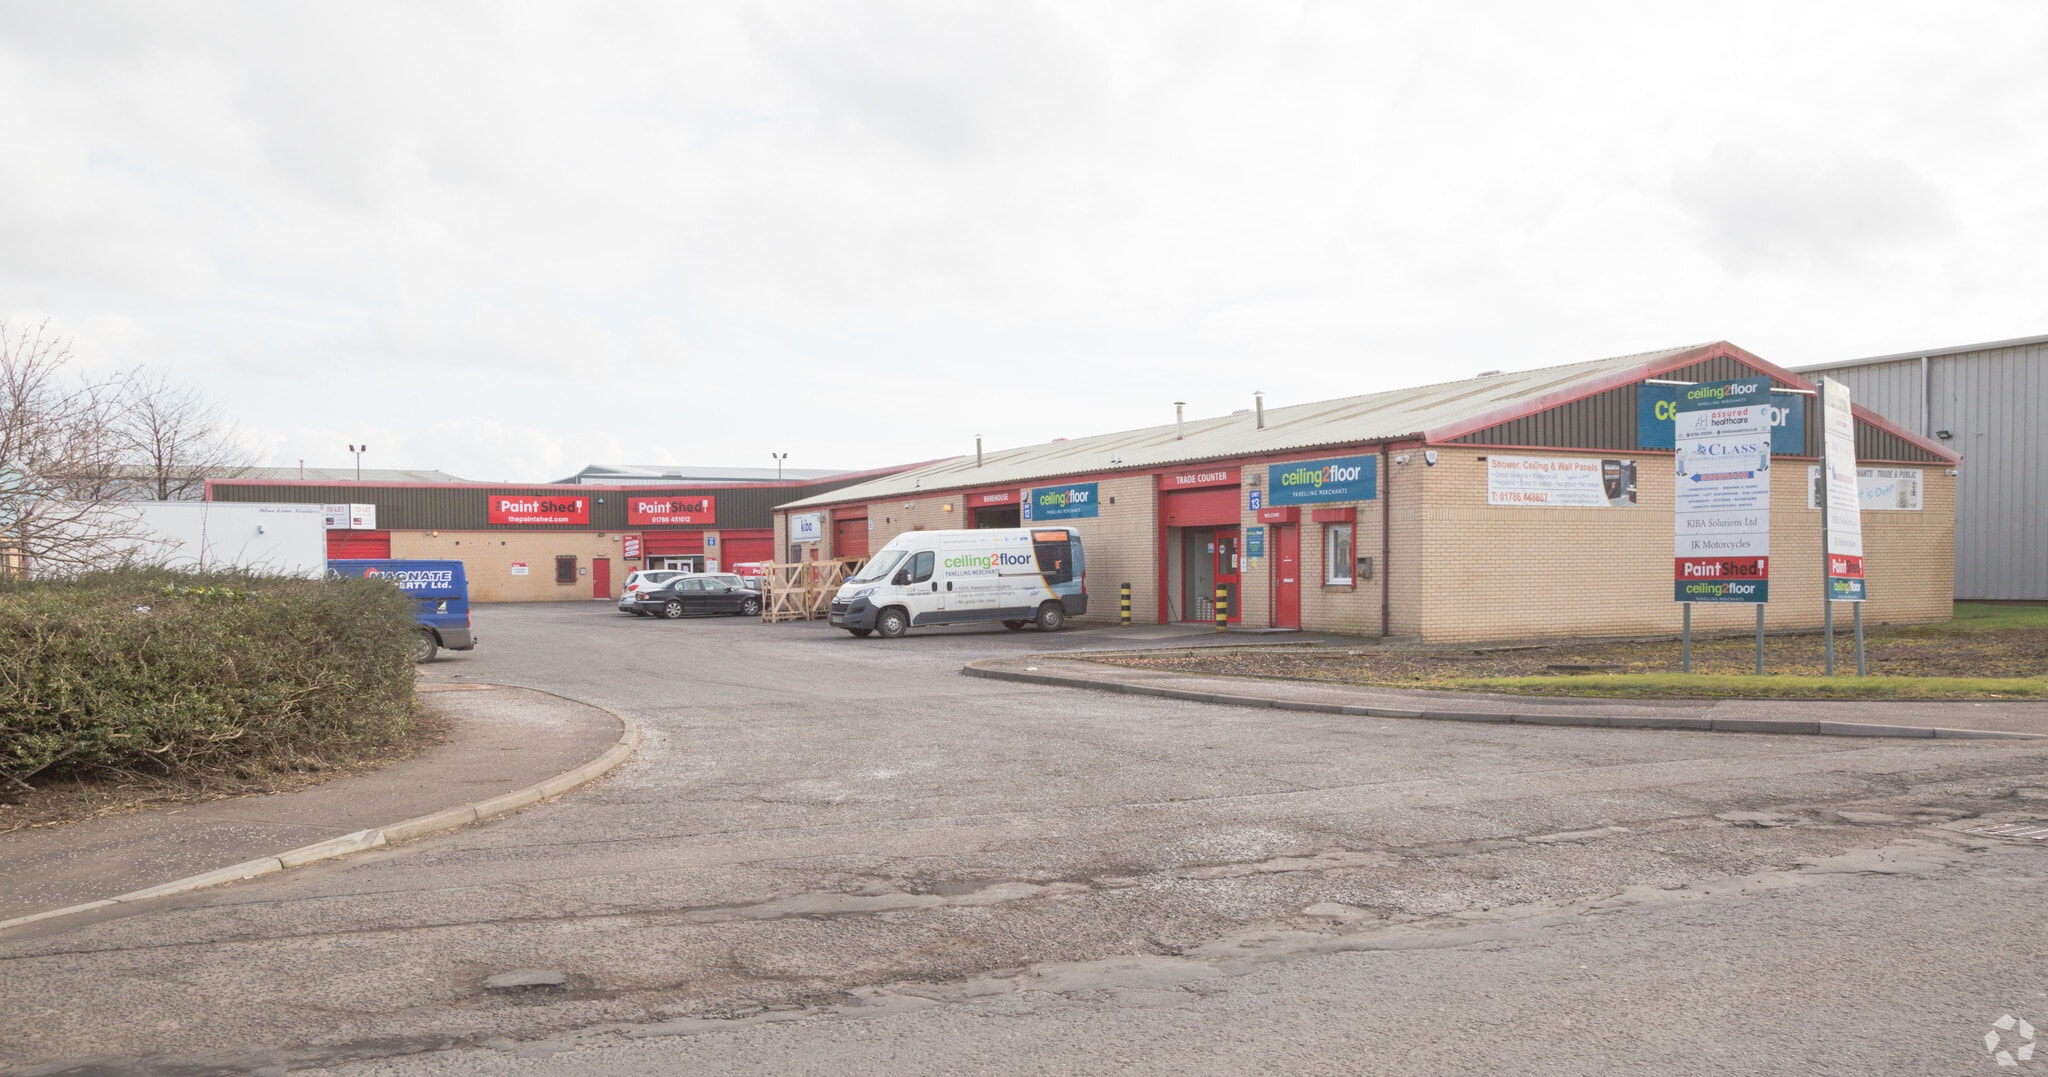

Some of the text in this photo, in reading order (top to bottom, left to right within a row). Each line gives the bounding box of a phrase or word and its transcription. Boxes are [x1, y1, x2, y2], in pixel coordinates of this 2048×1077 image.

[1688, 383, 1758, 400] ceiling2floor
[1712, 408, 1748, 418] assured
[1712, 416, 1748, 426] healthcare
[1492, 460, 1522, 470] Shower,
[1524, 460, 1548, 472] Ceiling
[1550, 462, 1556, 470] &
[1558, 462, 1572, 470] Wall
[1574, 463, 1598, 472] Panels
[1176, 472, 1227, 484] TRADE COUNTER
[1282, 465, 1361, 488] ceiling2floor
[1877, 470, 1893, 478] TRADE
[983, 493, 1008, 502] WAREHOUSE
[1319, 488, 1348, 496] MERCHANTS
[1492, 492, 1498, 502] T:
[1500, 492, 1521, 502] 01786
[1040, 489, 1089, 508] ceiling2floor
[1250, 498, 1260, 509] 13
[502, 500, 540, 513] Paint
[541, 500, 576, 513] Shed
[638, 501, 671, 514] Paint
[672, 502, 702, 513] Shed
[508, 516, 569, 524] thepaintshed.com
[1687, 518, 1758, 528] KIBA Solutions Ltd
[1691, 540, 1750, 550] JK Motorcycles
[944, 552, 1032, 570] ceiling2floor
[1832, 558, 1860, 574] Paint Shed
[972, 568, 1000, 576] MERCHANTS
[1684, 561, 1722, 576] Paint
[1722, 561, 1757, 576] Shed
[394, 582, 428, 590] ERTY
[1686, 582, 1756, 596] ceiling2floor
